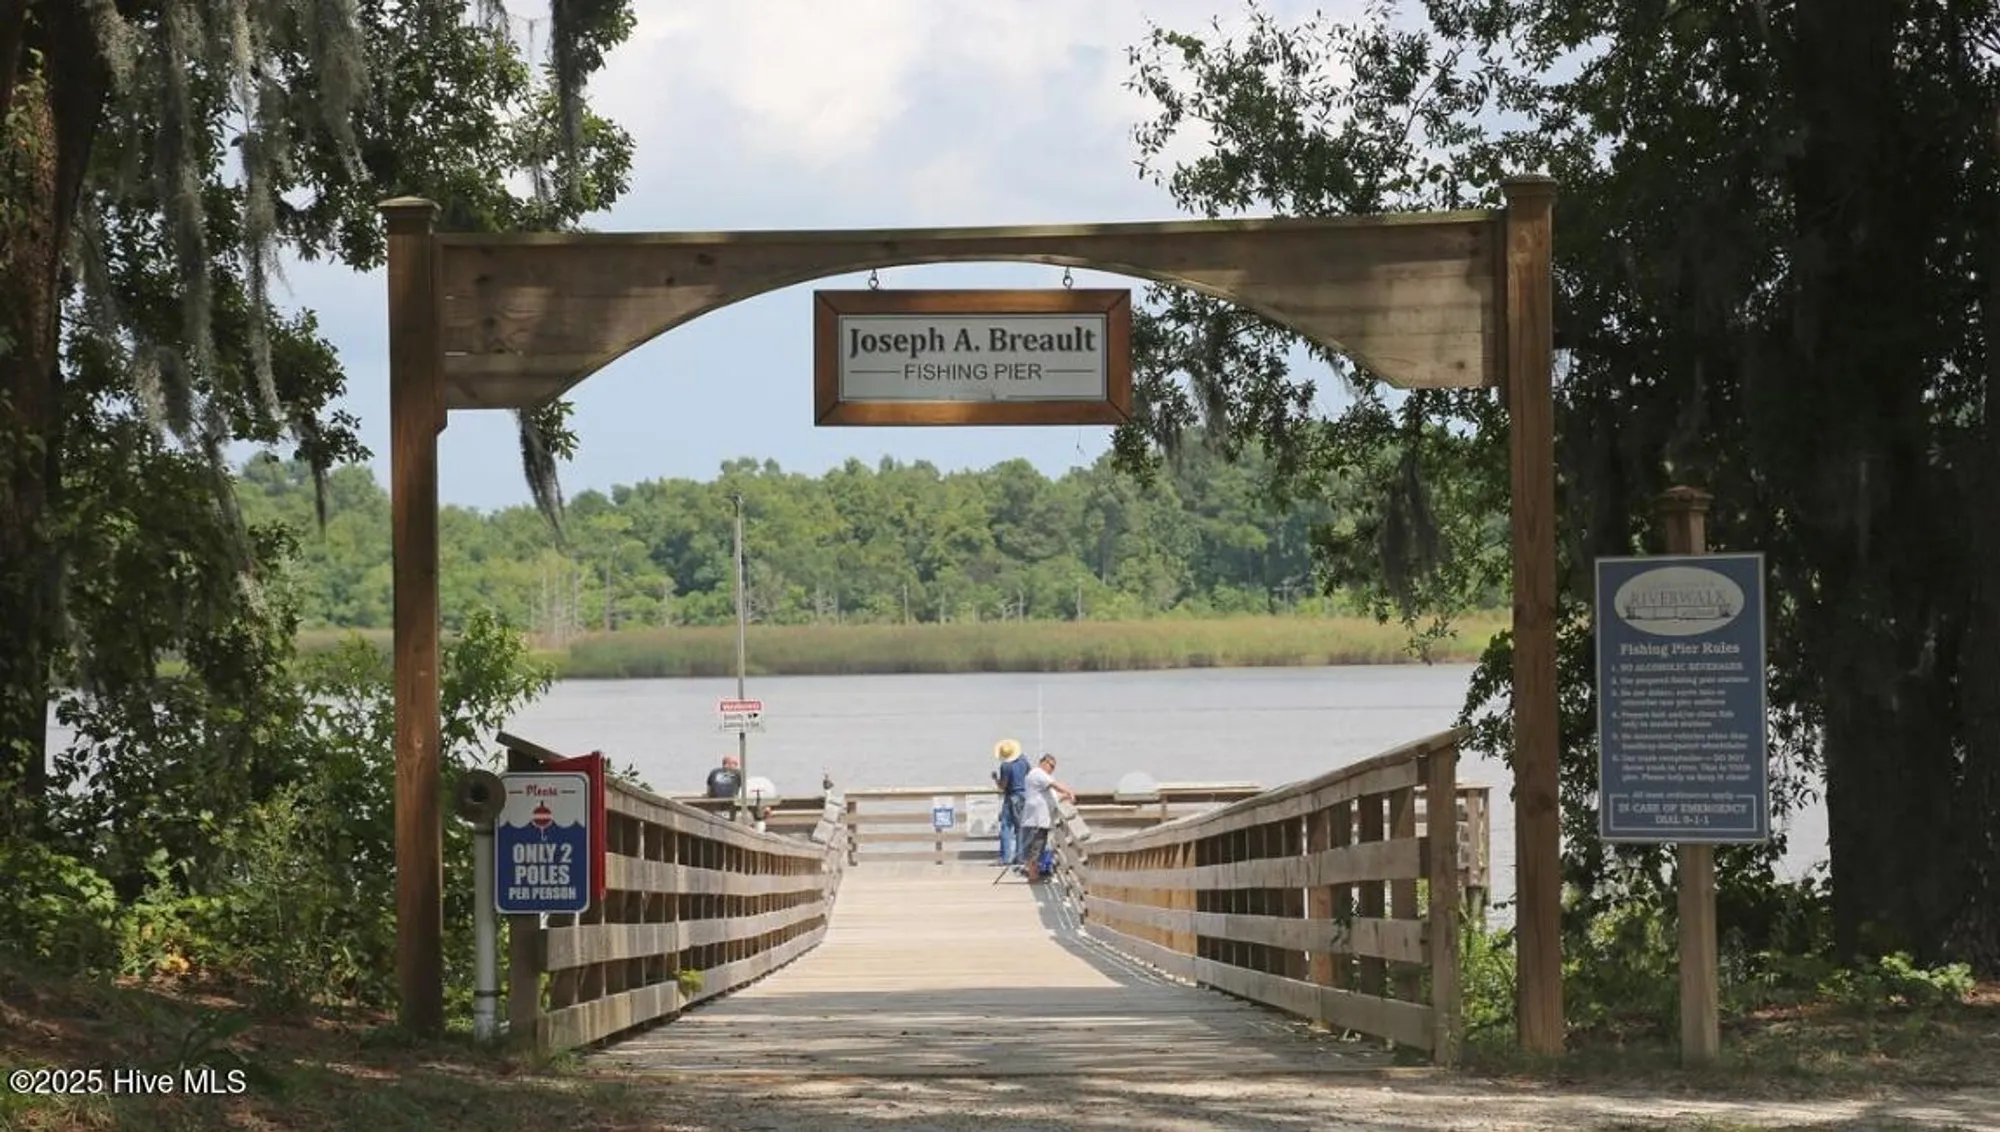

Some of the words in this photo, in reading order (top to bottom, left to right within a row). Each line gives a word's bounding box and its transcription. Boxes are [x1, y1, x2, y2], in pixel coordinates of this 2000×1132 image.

[850, 327, 945, 358] Joseph
[953, 328, 981, 351] A.
[988, 326, 1096, 352] Breault
[904, 363, 987, 380] FISHING
[994, 363, 1041, 380] PIER
[1631, 590, 1726, 605] RIVERWALK
[1620, 644, 1668, 658] Fishing
[1671, 644, 1699, 654] Pier
[1702, 642, 1740, 653] Rules
[1635, 663, 1686, 671] ALCOHOLIC
[1618, 804, 1629, 812] IN
[1633, 804, 1660, 812] CASE
[1663, 804, 1678, 812] OF
[1680, 804, 1748, 812] EMERGENCY
[1655, 816, 1679, 824] DIAL
[1682, 816, 1709, 824] 9-1-1
[512, 843, 557, 864] ONLY
[560, 844, 573, 864] 2
[514, 864, 570, 885] POLES
[508, 886, 530, 900] PER
[532, 886, 577, 900] PERSON
